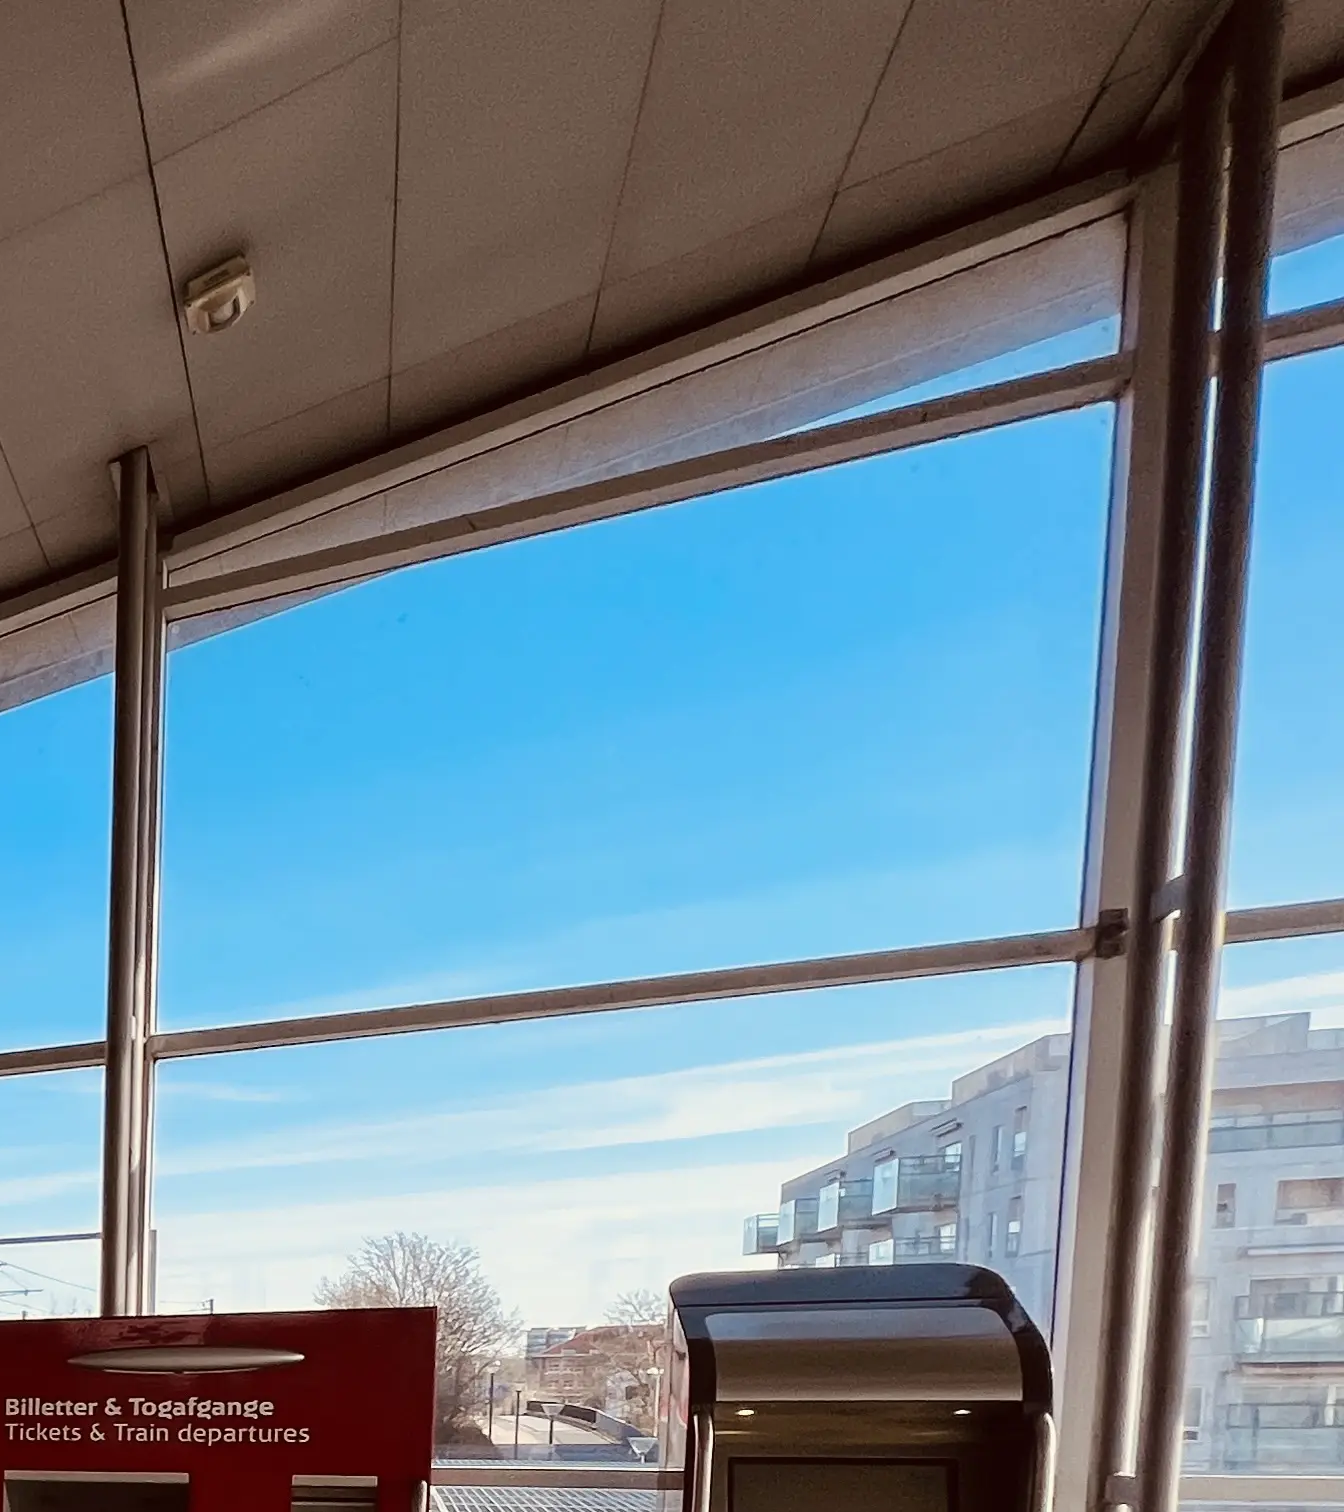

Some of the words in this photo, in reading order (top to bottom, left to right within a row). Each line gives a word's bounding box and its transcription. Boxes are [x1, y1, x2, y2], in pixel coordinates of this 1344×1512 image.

[5, 1397, 98, 1416] Billetter
[104, 1397, 122, 1416] &
[128, 1397, 274, 1420] Togafgange
[4, 1422, 82, 1441] Tickets
[90, 1422, 106, 1441] &
[113, 1423, 169, 1442] Train
[177, 1423, 310, 1447] departures
